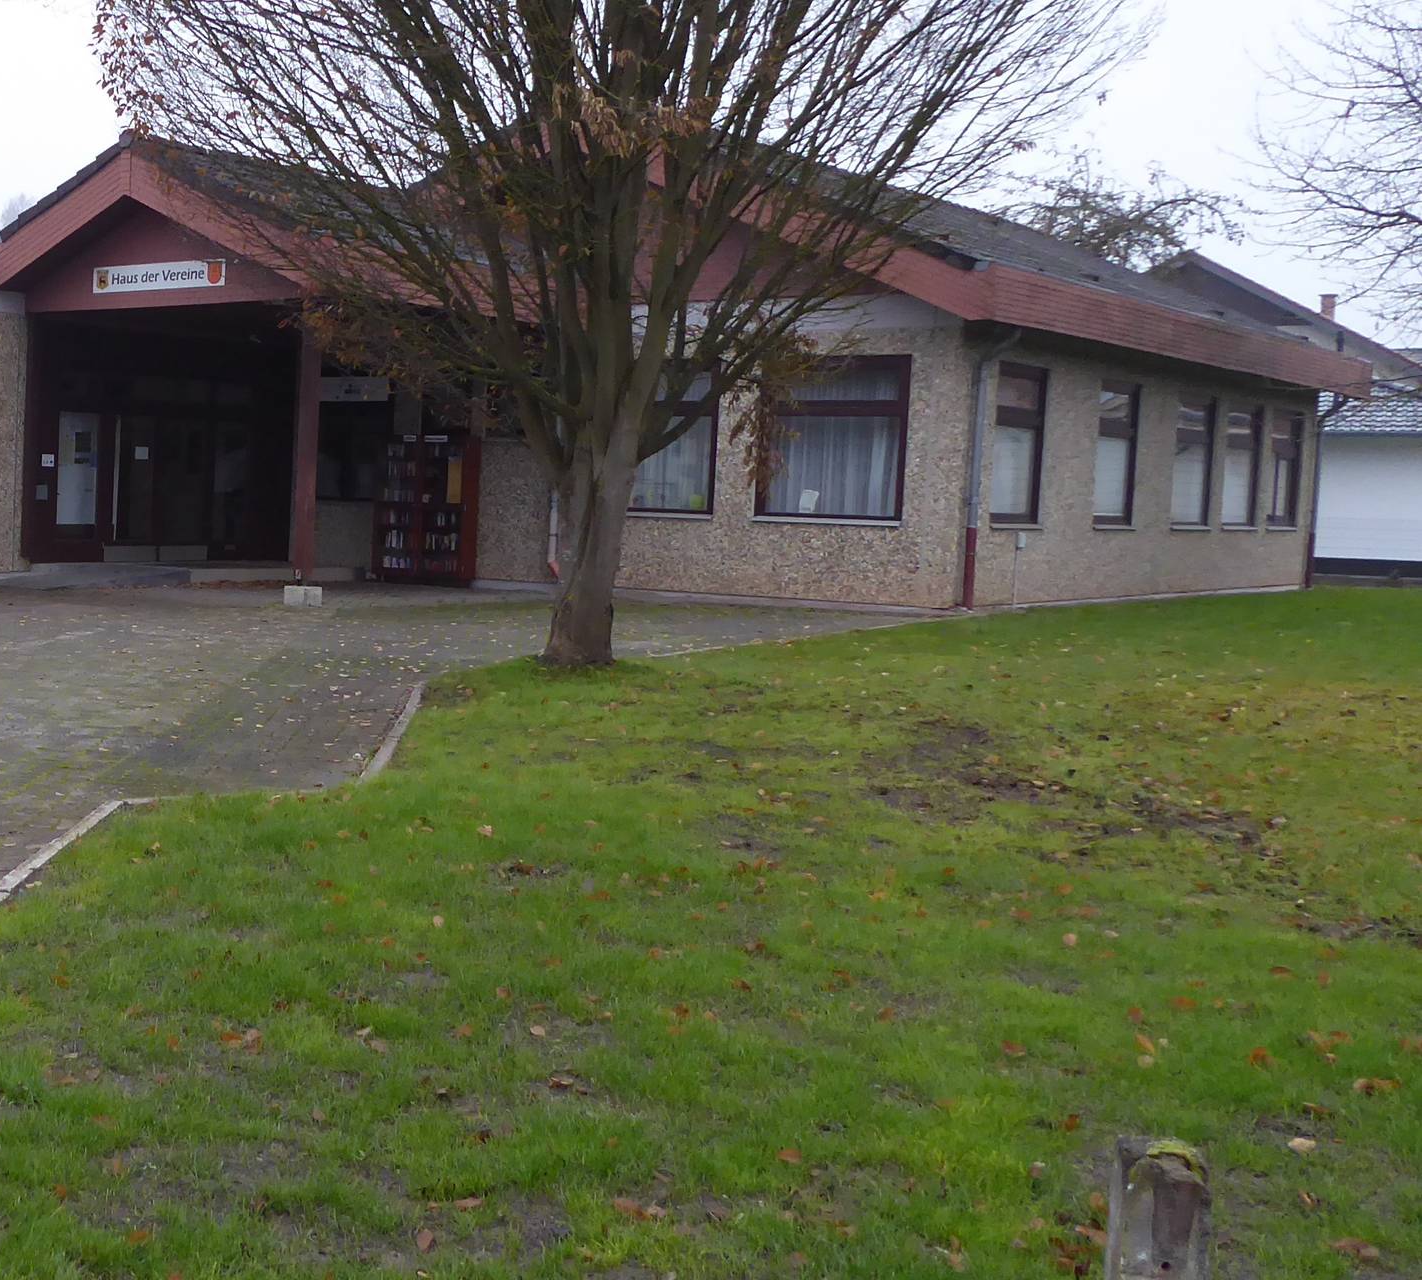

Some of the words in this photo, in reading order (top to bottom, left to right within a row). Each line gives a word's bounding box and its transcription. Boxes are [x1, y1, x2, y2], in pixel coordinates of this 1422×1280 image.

[111, 273, 138, 285] Haus
[141, 271, 159, 283] der
[162, 268, 205, 281] Vereine
